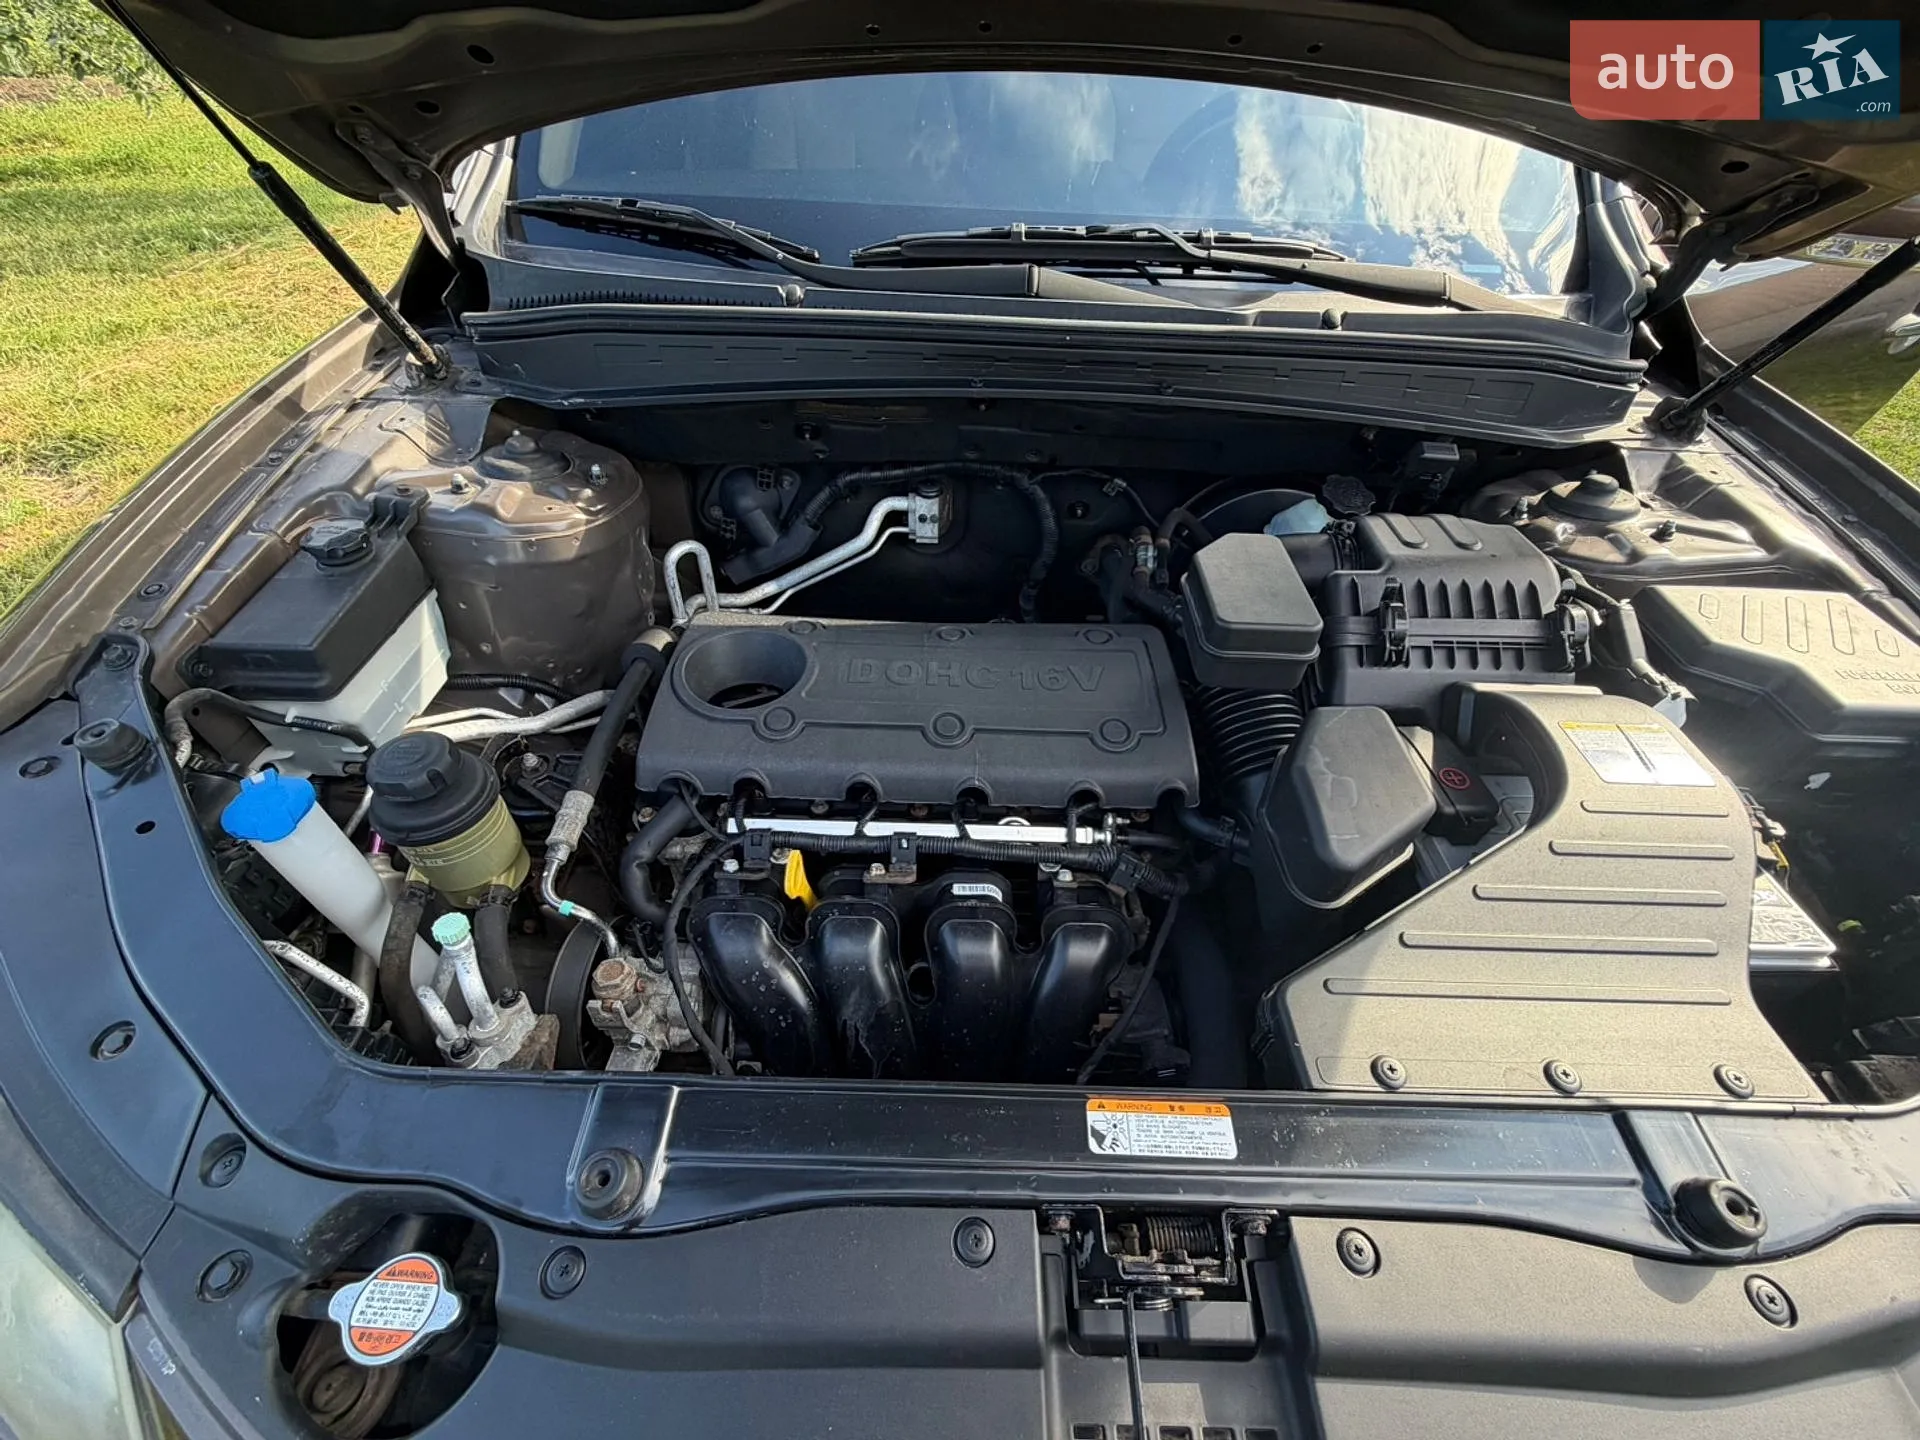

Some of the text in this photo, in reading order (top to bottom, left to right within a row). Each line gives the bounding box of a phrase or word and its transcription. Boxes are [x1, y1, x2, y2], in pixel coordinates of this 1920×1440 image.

[847, 658, 1105, 692] DOHC 16V
[1115, 1102, 1153, 1111] WARNING
[397, 1268, 434, 1280] WARNING
